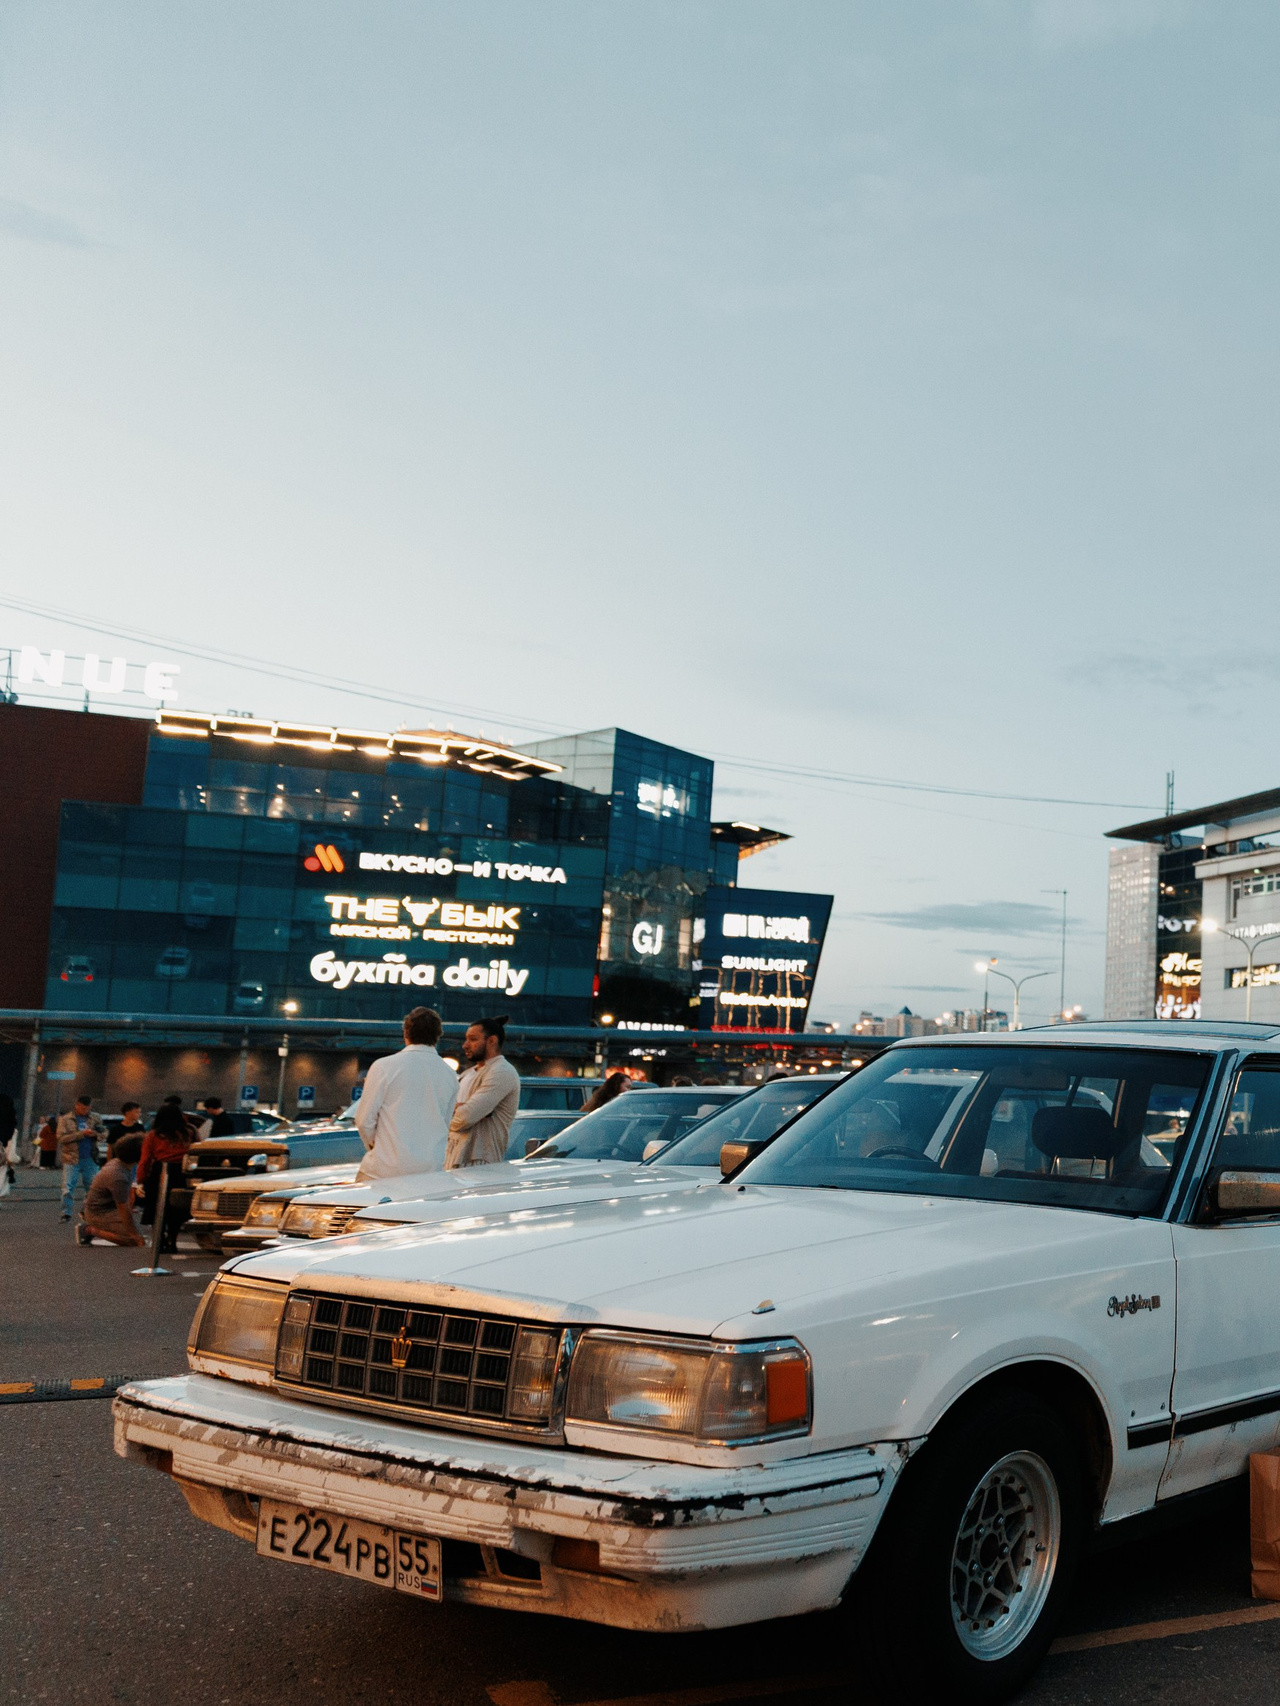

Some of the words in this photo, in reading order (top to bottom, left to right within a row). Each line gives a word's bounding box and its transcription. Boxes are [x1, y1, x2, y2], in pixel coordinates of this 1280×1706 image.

[495, 862, 567, 884] ТОЧКА
[323, 895, 400, 923] THE
[440, 902, 521, 930] БЫК
[330, 923, 411, 940] МЯСНОЙ
[422, 928, 514, 946] РЕСТОРАН
[721, 955, 808, 973] SUNLIGHT
[442, 957, 530, 996] daily
[399, 1535, 430, 1576] 55
[398, 1572, 421, 1590] RUS
